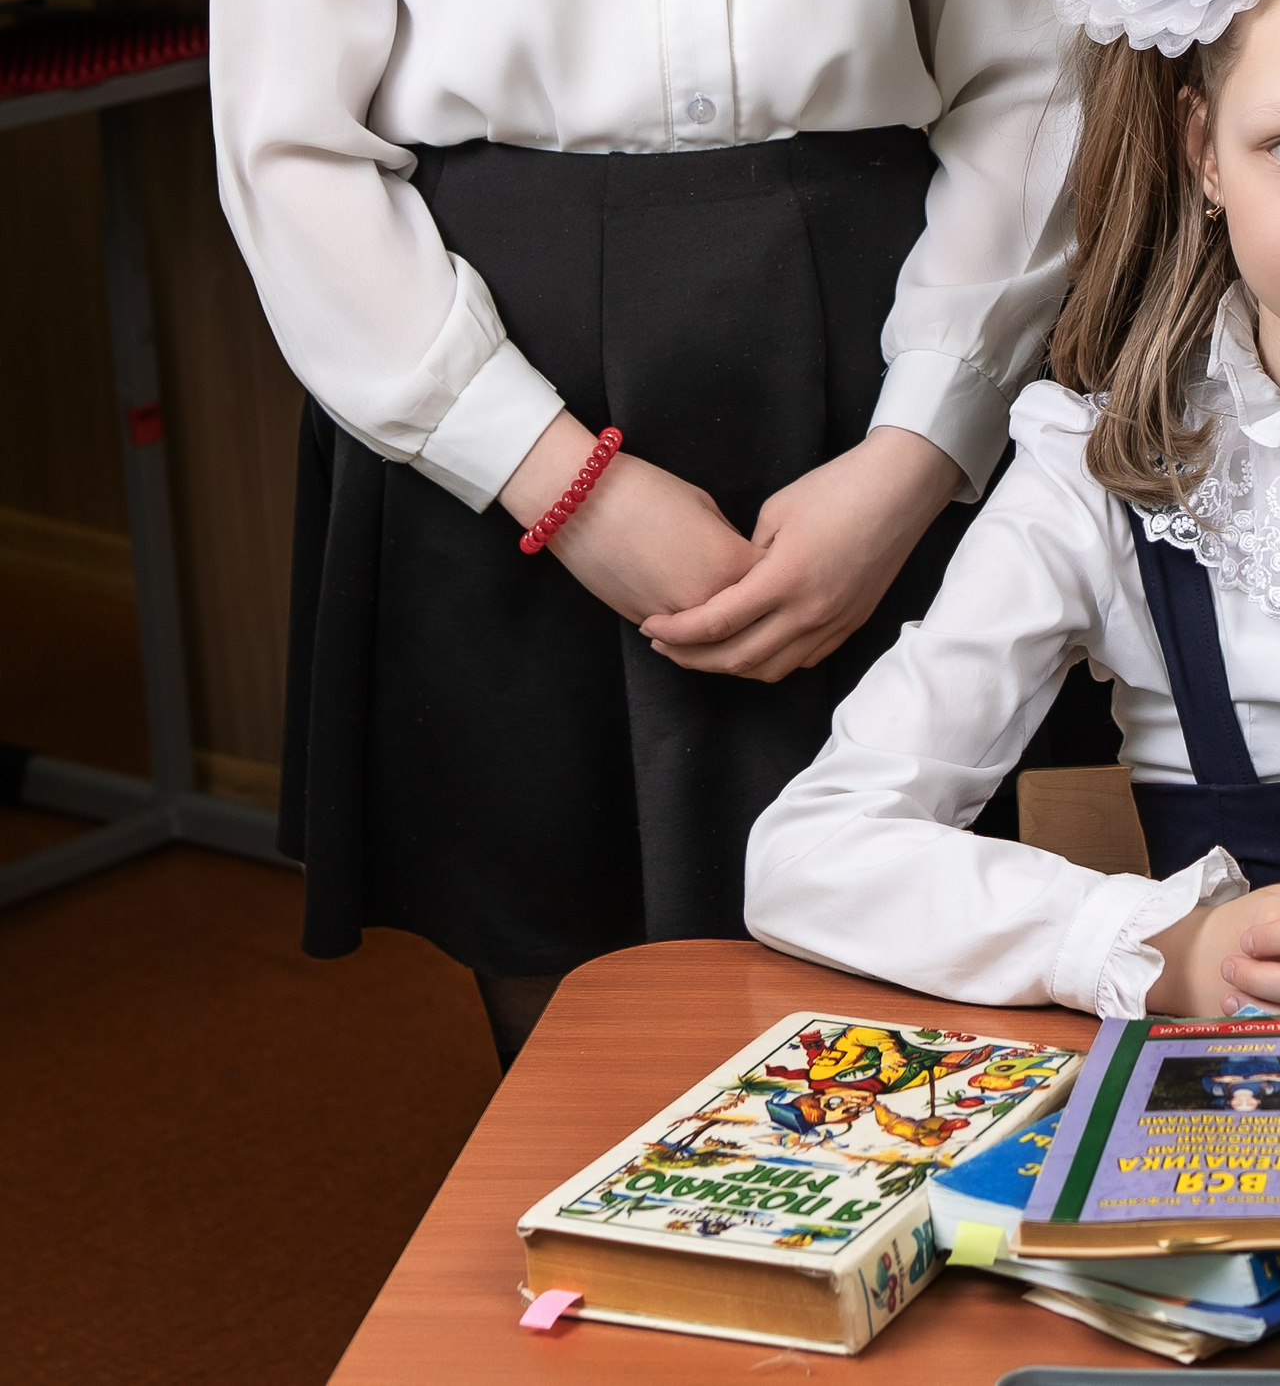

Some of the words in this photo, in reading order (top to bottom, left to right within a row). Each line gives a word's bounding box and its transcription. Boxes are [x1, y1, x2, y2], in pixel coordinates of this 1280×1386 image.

[1138, 1115, 1235, 1127] ЗАДАЧАМИ
[722, 1164, 840, 1194] МИР
[1174, 1171, 1269, 1194] ВСЯ
[624, 1170, 833, 1217] ПОЗНАЮ
[826, 1199, 882, 1222] Я
